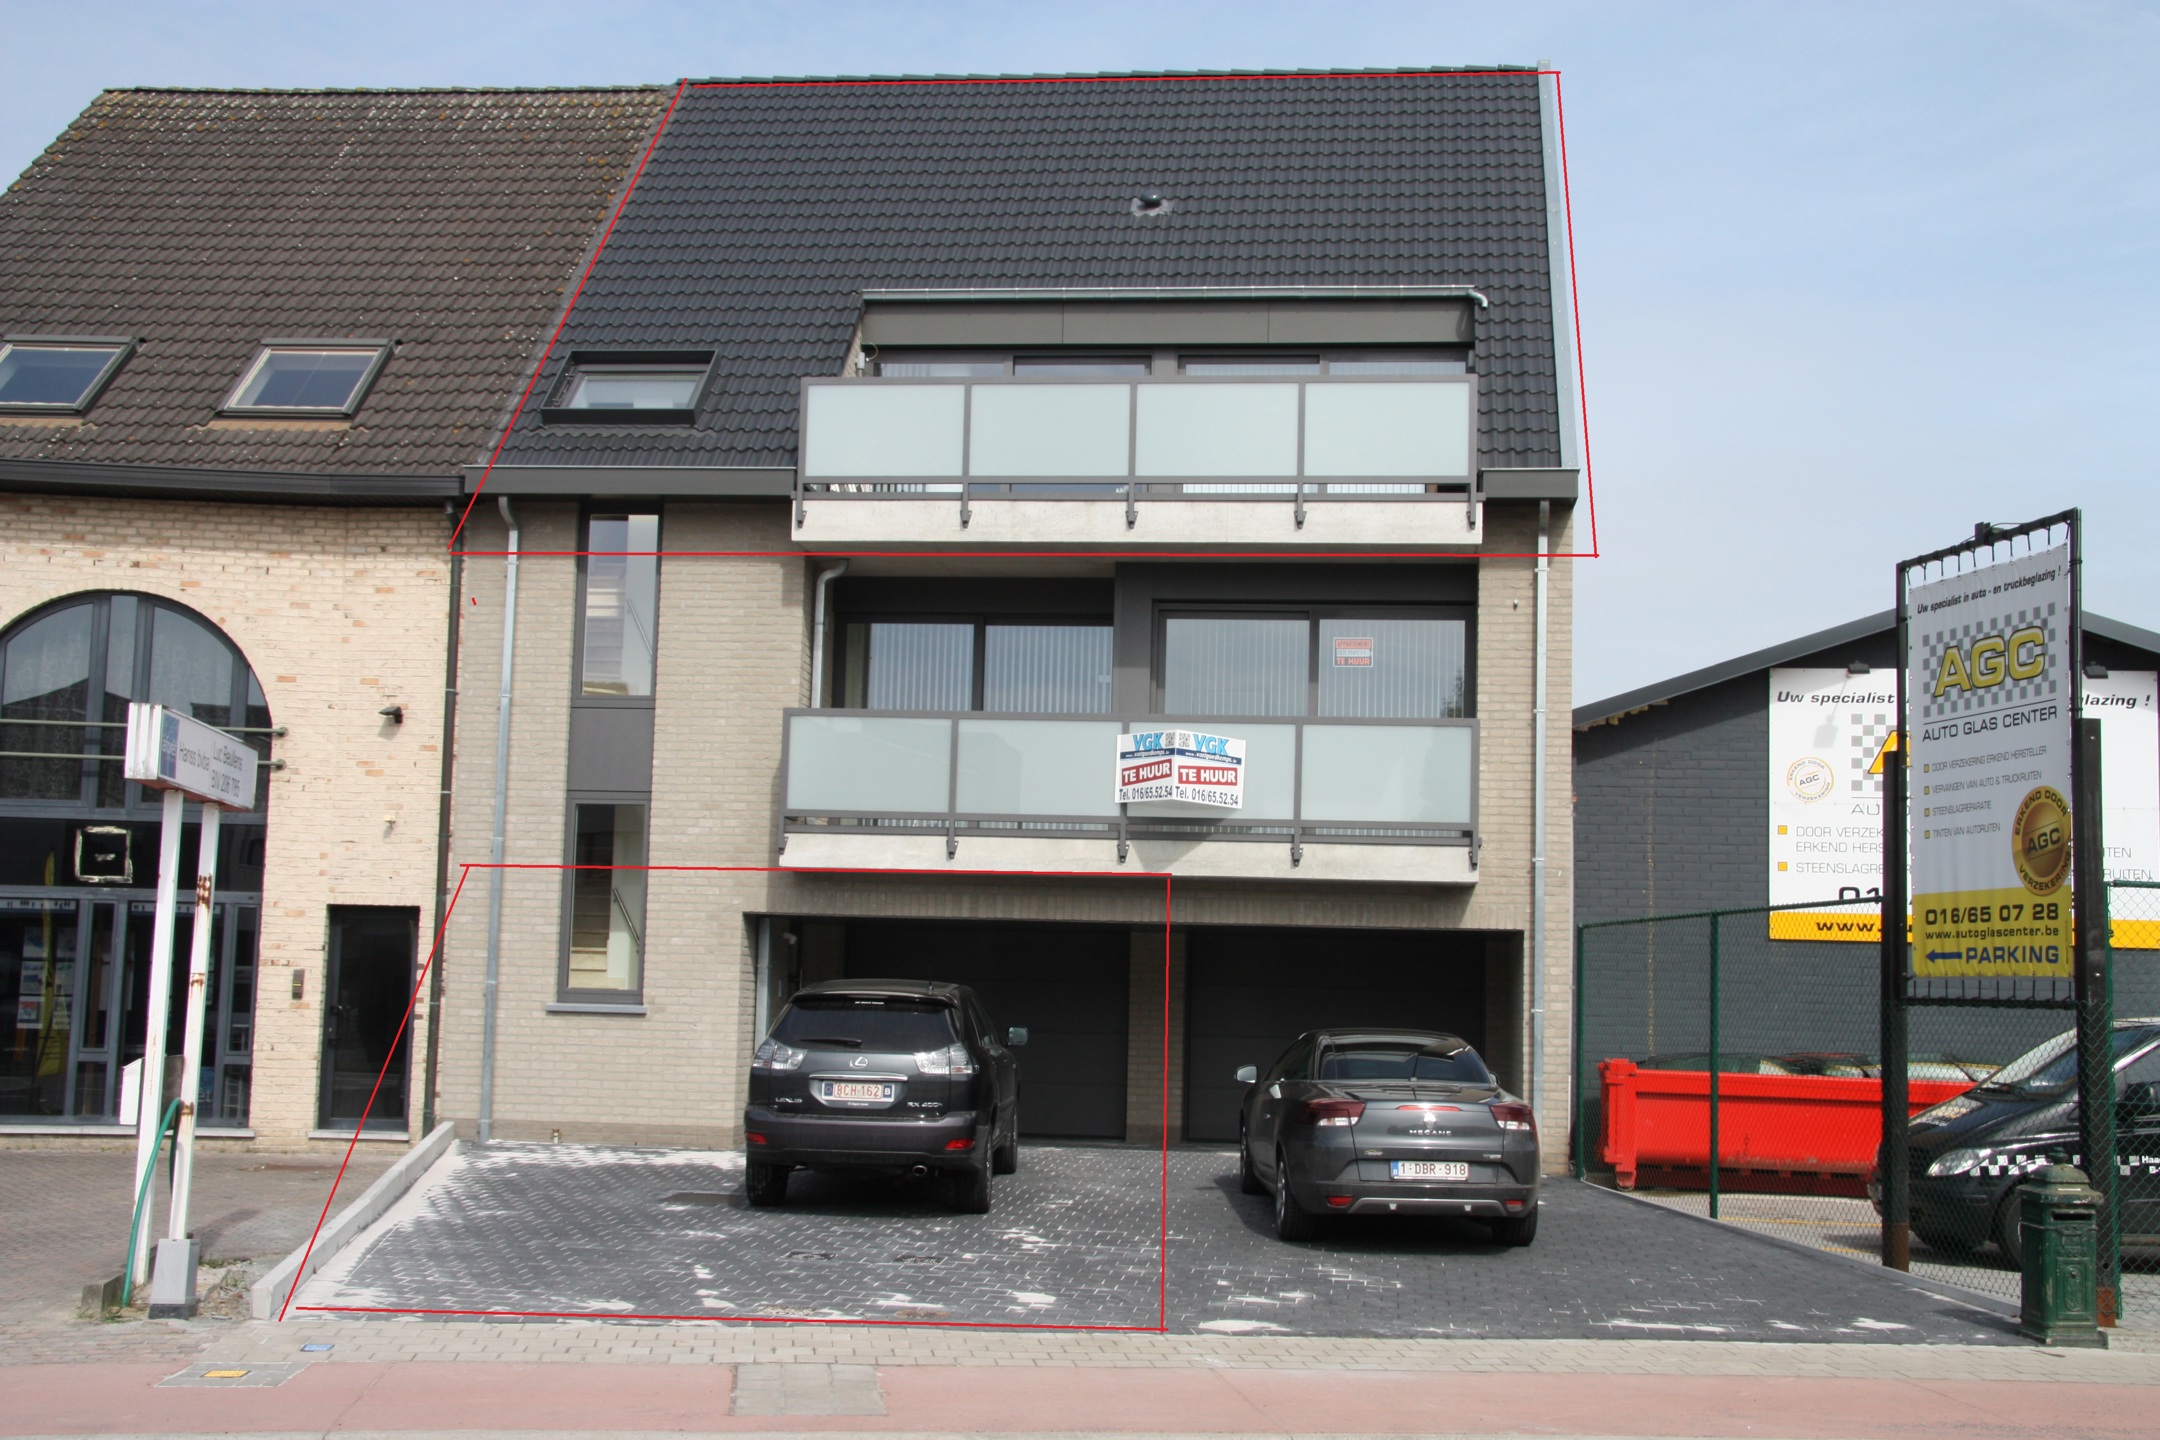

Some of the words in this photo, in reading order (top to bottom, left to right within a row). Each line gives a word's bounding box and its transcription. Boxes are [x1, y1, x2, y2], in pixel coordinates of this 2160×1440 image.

[1917, 604, 1928, 614] Uw
[1930, 595, 1962, 613] specialist
[1963, 592, 1969, 603] in
[1971, 589, 1987, 600] auto
[1993, 585, 2001, 595] en
[2004, 569, 2056, 592] truckbeglazing
[1336, 657, 1345, 665] TE
[1348, 657, 1370, 665] HUUR
[1934, 626, 2045, 697] AGC
[1777, 691, 1804, 703] Uw
[1810, 692, 1895, 706] specialist
[2084, 694, 2137, 709] lazing
[1922, 724, 1958, 742] AUTO
[1963, 716, 1998, 735] GLAS
[2003, 705, 2057, 728] CENTER
[1132, 732, 1164, 751] VGK
[1192, 734, 1229, 756] VGK
[1932, 761, 1947, 772] DOOR
[1949, 755, 1986, 769] VERZEKERING
[1987, 751, 2009, 764] ERKEND
[2011, 745, 2047, 759] HERSTELLER
[1123, 770, 1137, 783] TE
[1139, 762, 1170, 780] HUUR
[1180, 768, 1197, 781] TE
[1201, 769, 1236, 783] HUUR
[1789, 761, 1806, 781] ERKEND
[1808, 760, 1825, 769] DOOR
[1800, 774, 1820, 786] AGC
[1795, 782, 1831, 800] VERZEKERING
[1932, 781, 1965, 794] VERVANGEN
[1966, 780, 1978, 789] VAN
[1979, 777, 1994, 787] AUTO
[2002, 770, 2042, 784] TRUCKRUITEN
[1119, 788, 1130, 800] Tel.
[1132, 785, 1173, 800] 016/65.52.54
[1175, 786, 1189, 799] Tel.
[1192, 788, 1239, 806] 016/65.52.54
[1933, 800, 1992, 816] STEENSLAGREPARATIE
[2015, 790, 2042, 836] ERKEND
[2044, 790, 2067, 816] DOOR
[1796, 826, 1831, 837] DOOR
[1836, 827, 1883, 838] VERZEK
[1933, 828, 1952, 838] TINTEN
[1952, 827, 1964, 836] VAN
[1966, 822, 2001, 835] AUTORUITEN
[1796, 841, 1848, 853] ERKEND
[2028, 827, 2060, 854] AGC
[1796, 862, 1883, 874] STEENSLAGRE
[2019, 851, 2071, 891] VERZEKERING
[1925, 906, 1991, 925] 016/65
[1999, 904, 2024, 922] 07
[2032, 903, 2059, 920] 28
[1925, 925, 2059, 940] www.autoglascenter.be
[1966, 945, 2059, 964] PARKING
[884, 1088, 891, 1096] B
